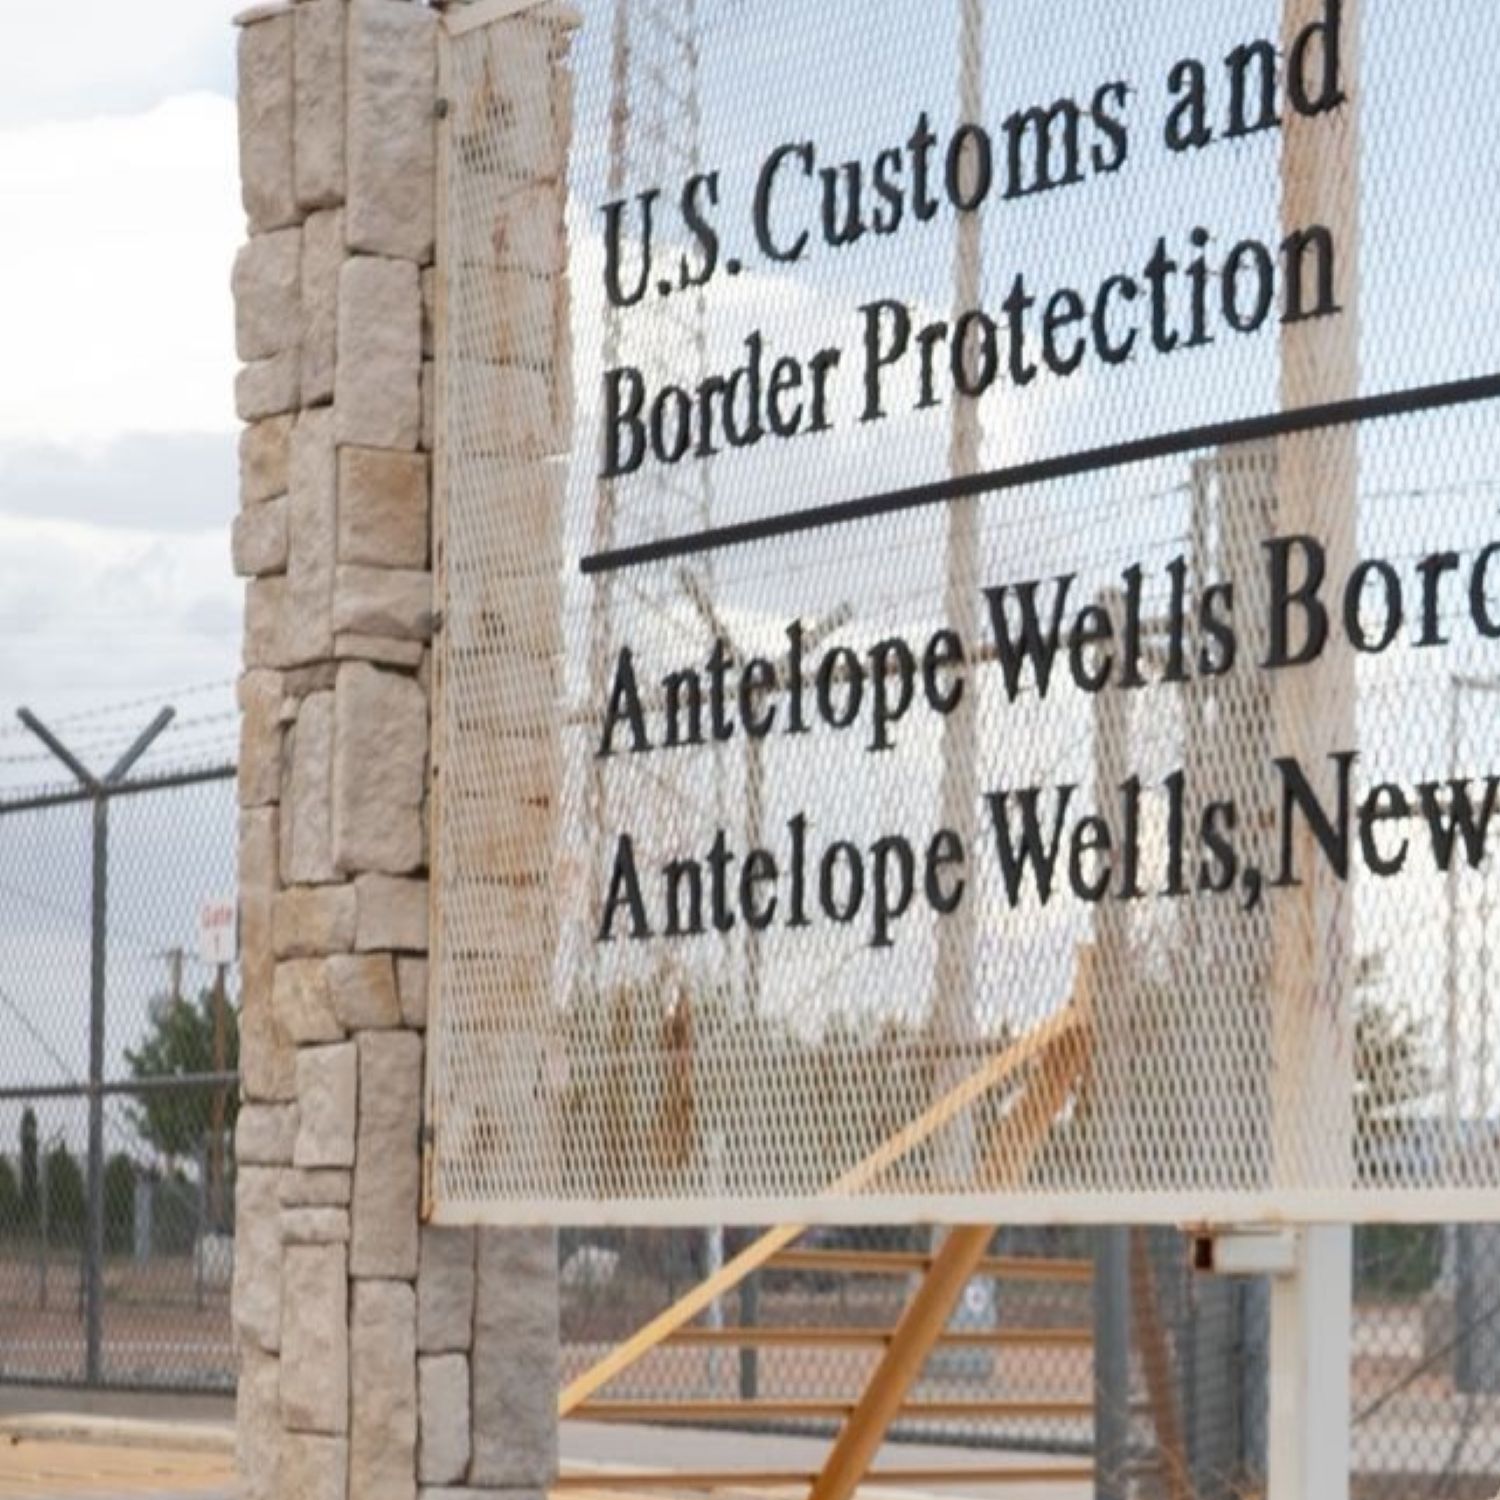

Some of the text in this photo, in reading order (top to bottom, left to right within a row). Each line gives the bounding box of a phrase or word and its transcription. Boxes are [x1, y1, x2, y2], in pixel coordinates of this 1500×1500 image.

[752, 78, 1129, 265] Customs
[1164, 0, 1345, 152] and
[601, 220, 1342, 479] Border Protection
[596, 618, 966, 758] Antelope
[982, 554, 1238, 704] Wells
[596, 811, 966, 949] Antelope
[984, 768, 1262, 910] Wells,
